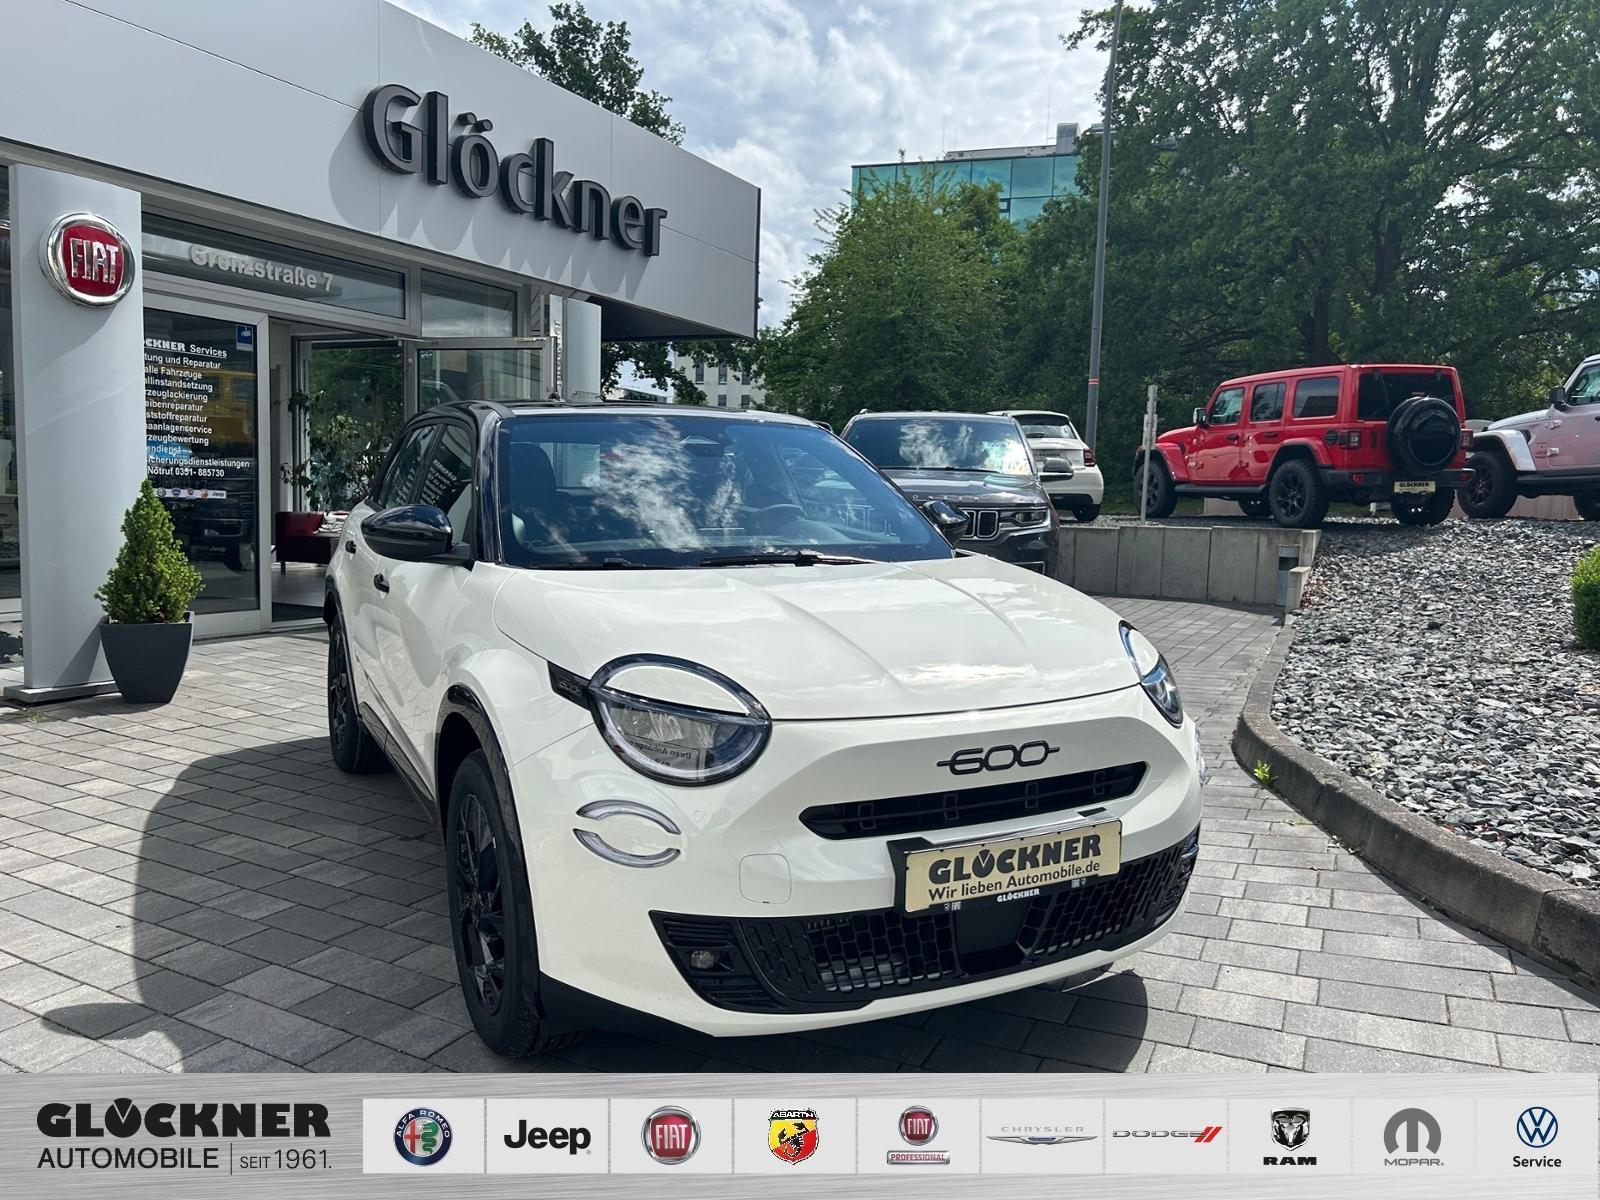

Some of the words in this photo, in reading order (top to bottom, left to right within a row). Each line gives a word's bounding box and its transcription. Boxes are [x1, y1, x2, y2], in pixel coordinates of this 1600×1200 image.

[362, 84, 668, 257] Glöckner
[70, 238, 118, 284] FIAT
[189, 244, 317, 288] Grenzstraße
[322, 272, 334, 291] 7
[144, 338, 185, 351] CKNER
[190, 344, 228, 357] Services
[161, 367, 202, 380] Fahrzeuge
[165, 356, 181, 364] und
[183, 357, 221, 369] Reparatur
[146, 422, 212, 434] aanlagenservice
[198, 468, 225, 477] 885730
[947, 740, 1050, 775] 600
[928, 886, 957, 901] Wir
[961, 878, 1002, 897] lieben
[1006, 860, 1101, 889] Automobile.de
